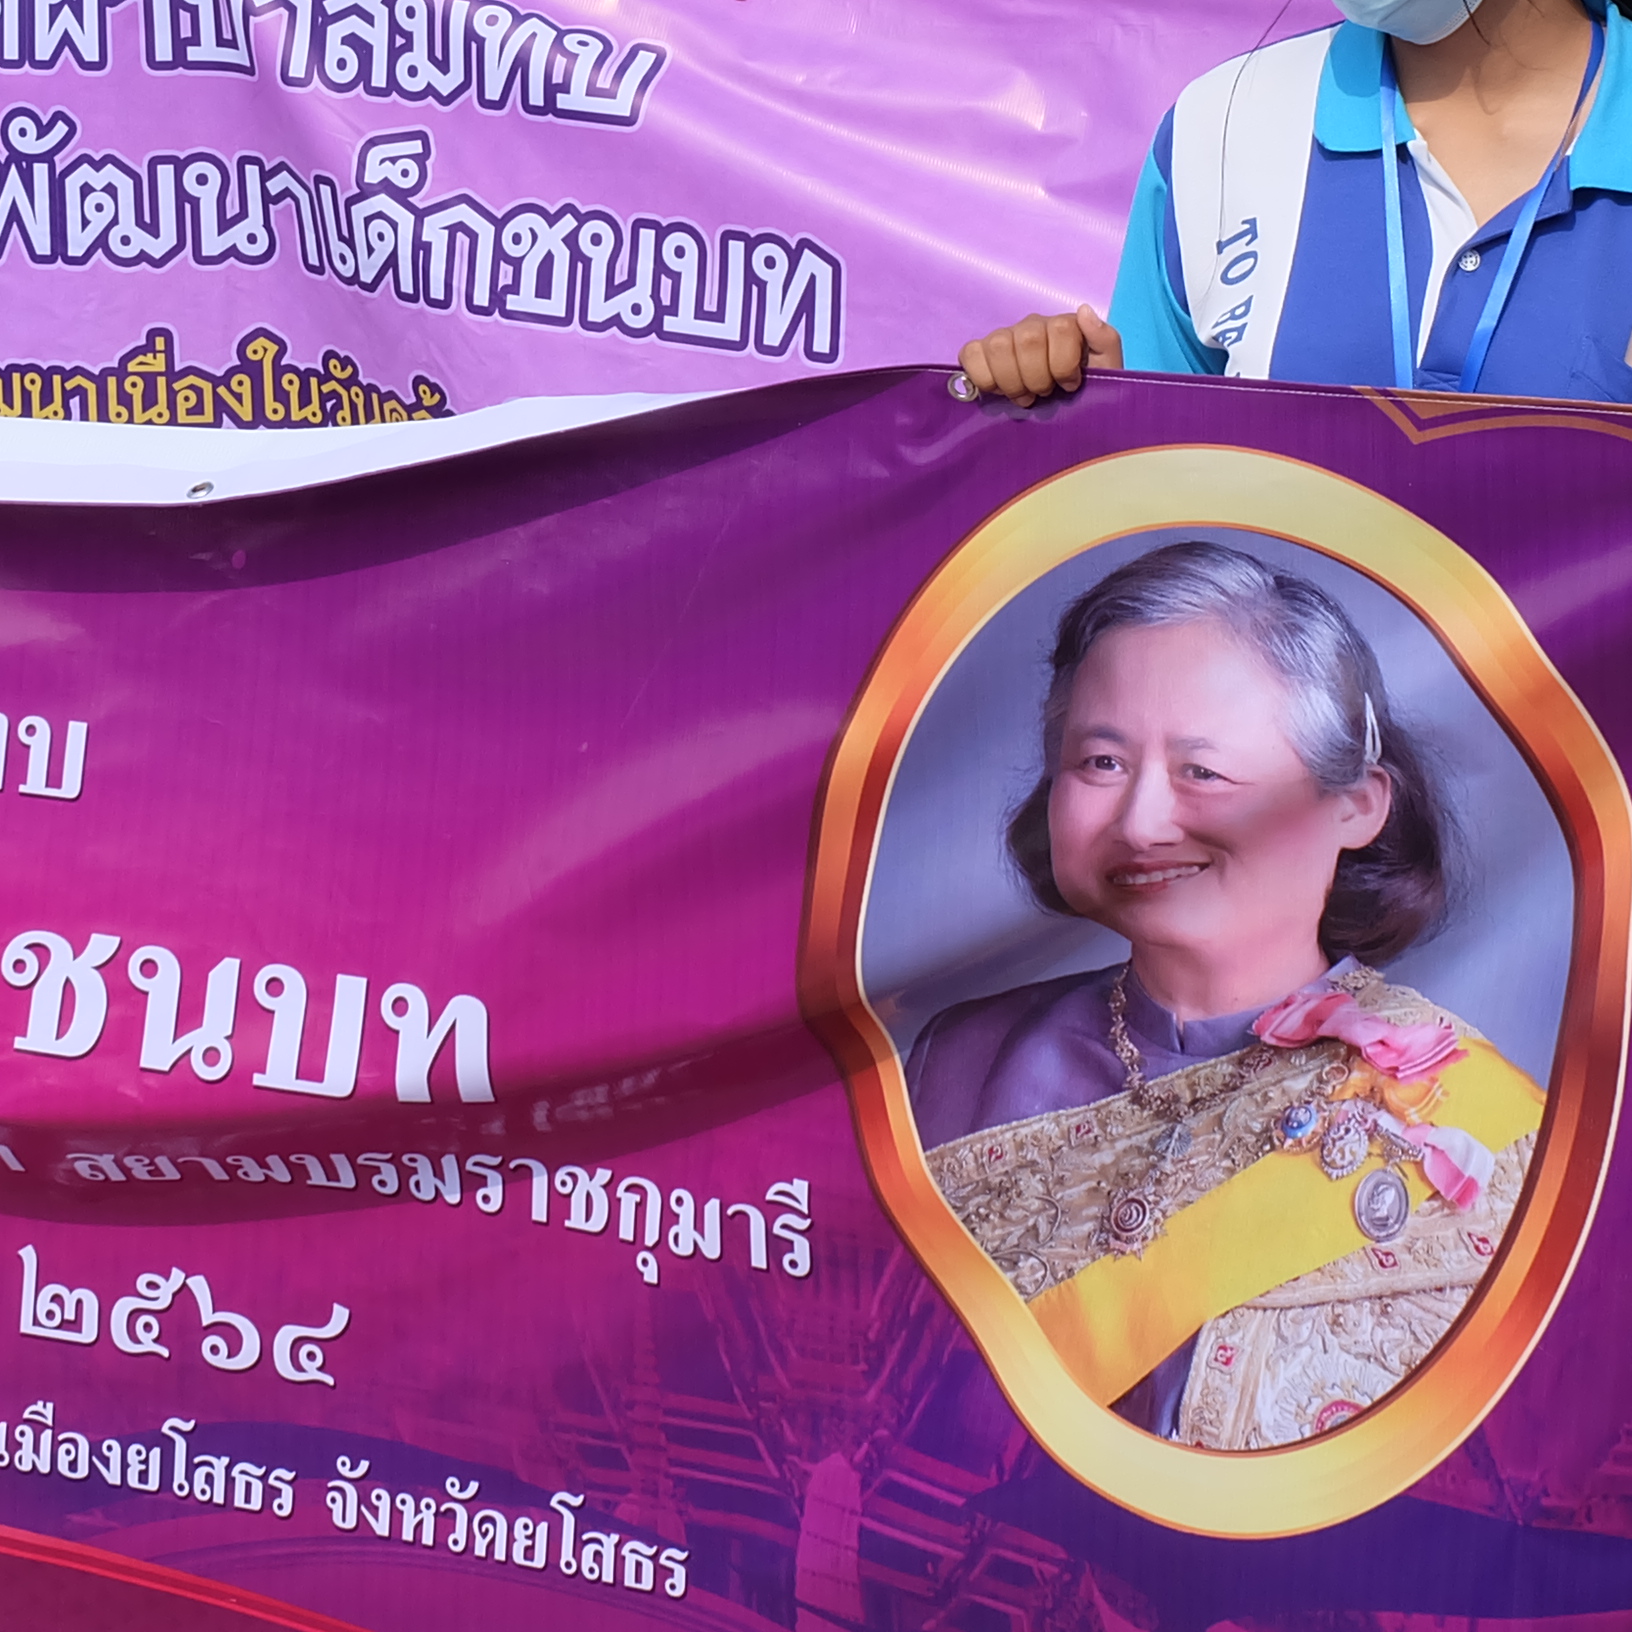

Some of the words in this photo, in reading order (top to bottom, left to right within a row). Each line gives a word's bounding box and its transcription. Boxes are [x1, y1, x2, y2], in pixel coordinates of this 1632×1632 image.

[1216, 217, 1258, 286] TO
[67, 1152, 813, 1284] สยามบรมราชกุมารี
[18, 1244, 351, 1386] ๒๕๖๔
[326, 1456, 688, 1598] จังหวัดยโสธร
